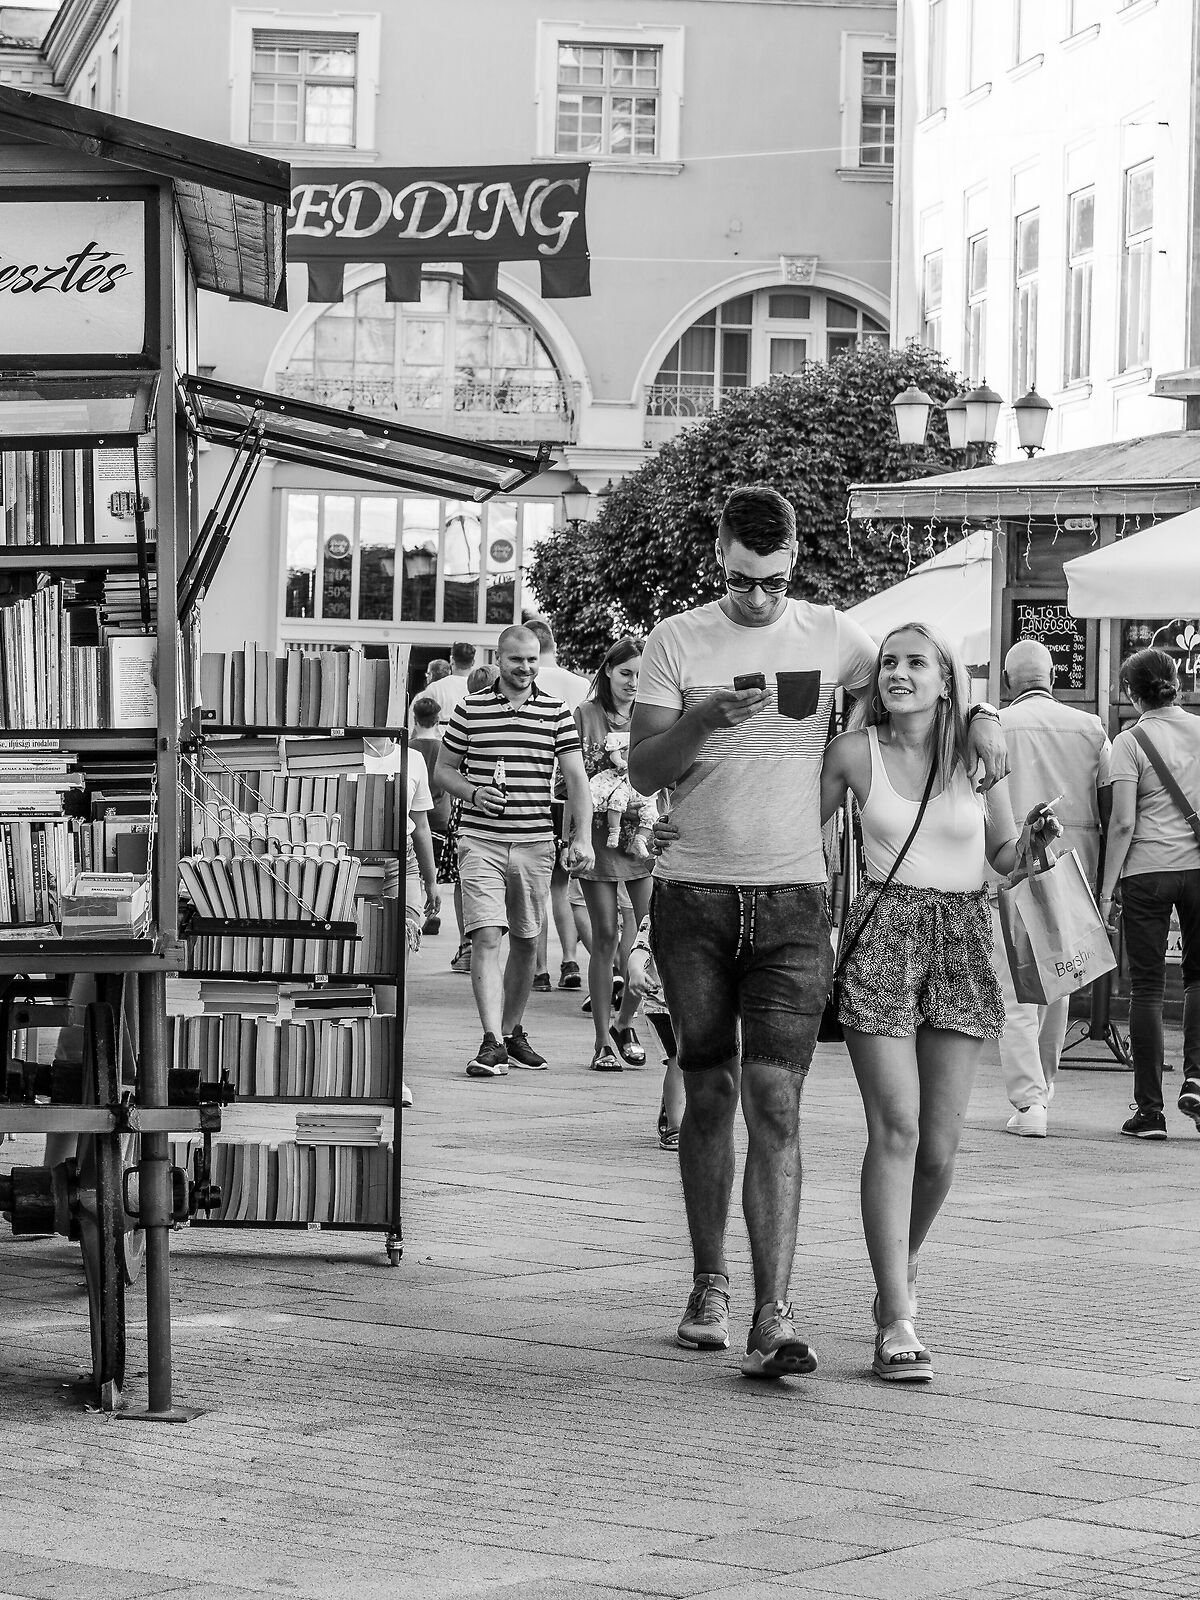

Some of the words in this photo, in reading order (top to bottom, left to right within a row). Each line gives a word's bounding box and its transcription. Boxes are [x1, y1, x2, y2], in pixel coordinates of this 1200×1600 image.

[287, 179, 580, 256] EDDING
[1046, 644, 1071, 652] EDVENCE
[32, 739, 59, 748] irodalom
[1054, 948, 1096, 978] Bersh
